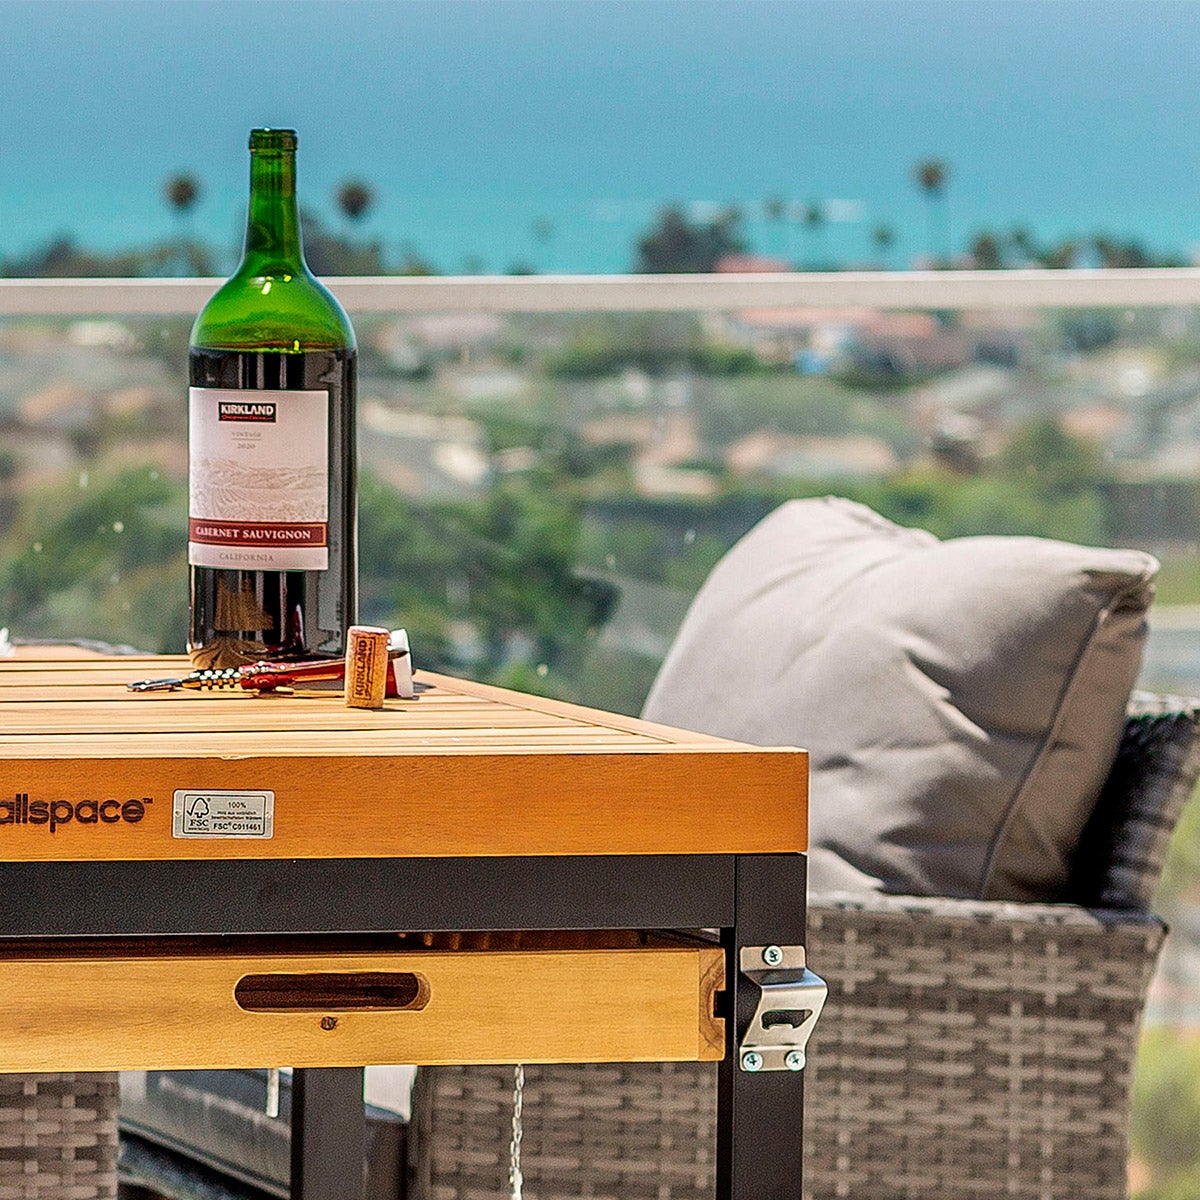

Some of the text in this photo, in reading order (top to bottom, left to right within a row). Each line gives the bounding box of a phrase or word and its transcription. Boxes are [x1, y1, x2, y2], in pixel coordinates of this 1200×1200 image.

[221, 403, 274, 415] KIRKLAND
[195, 526, 312, 540] CABERNET SAUVIGNON
[219, 552, 274, 562] CALIFORNIA
[355, 640, 367, 696] KIRKLAND
[190, 819, 209, 827] FSC
